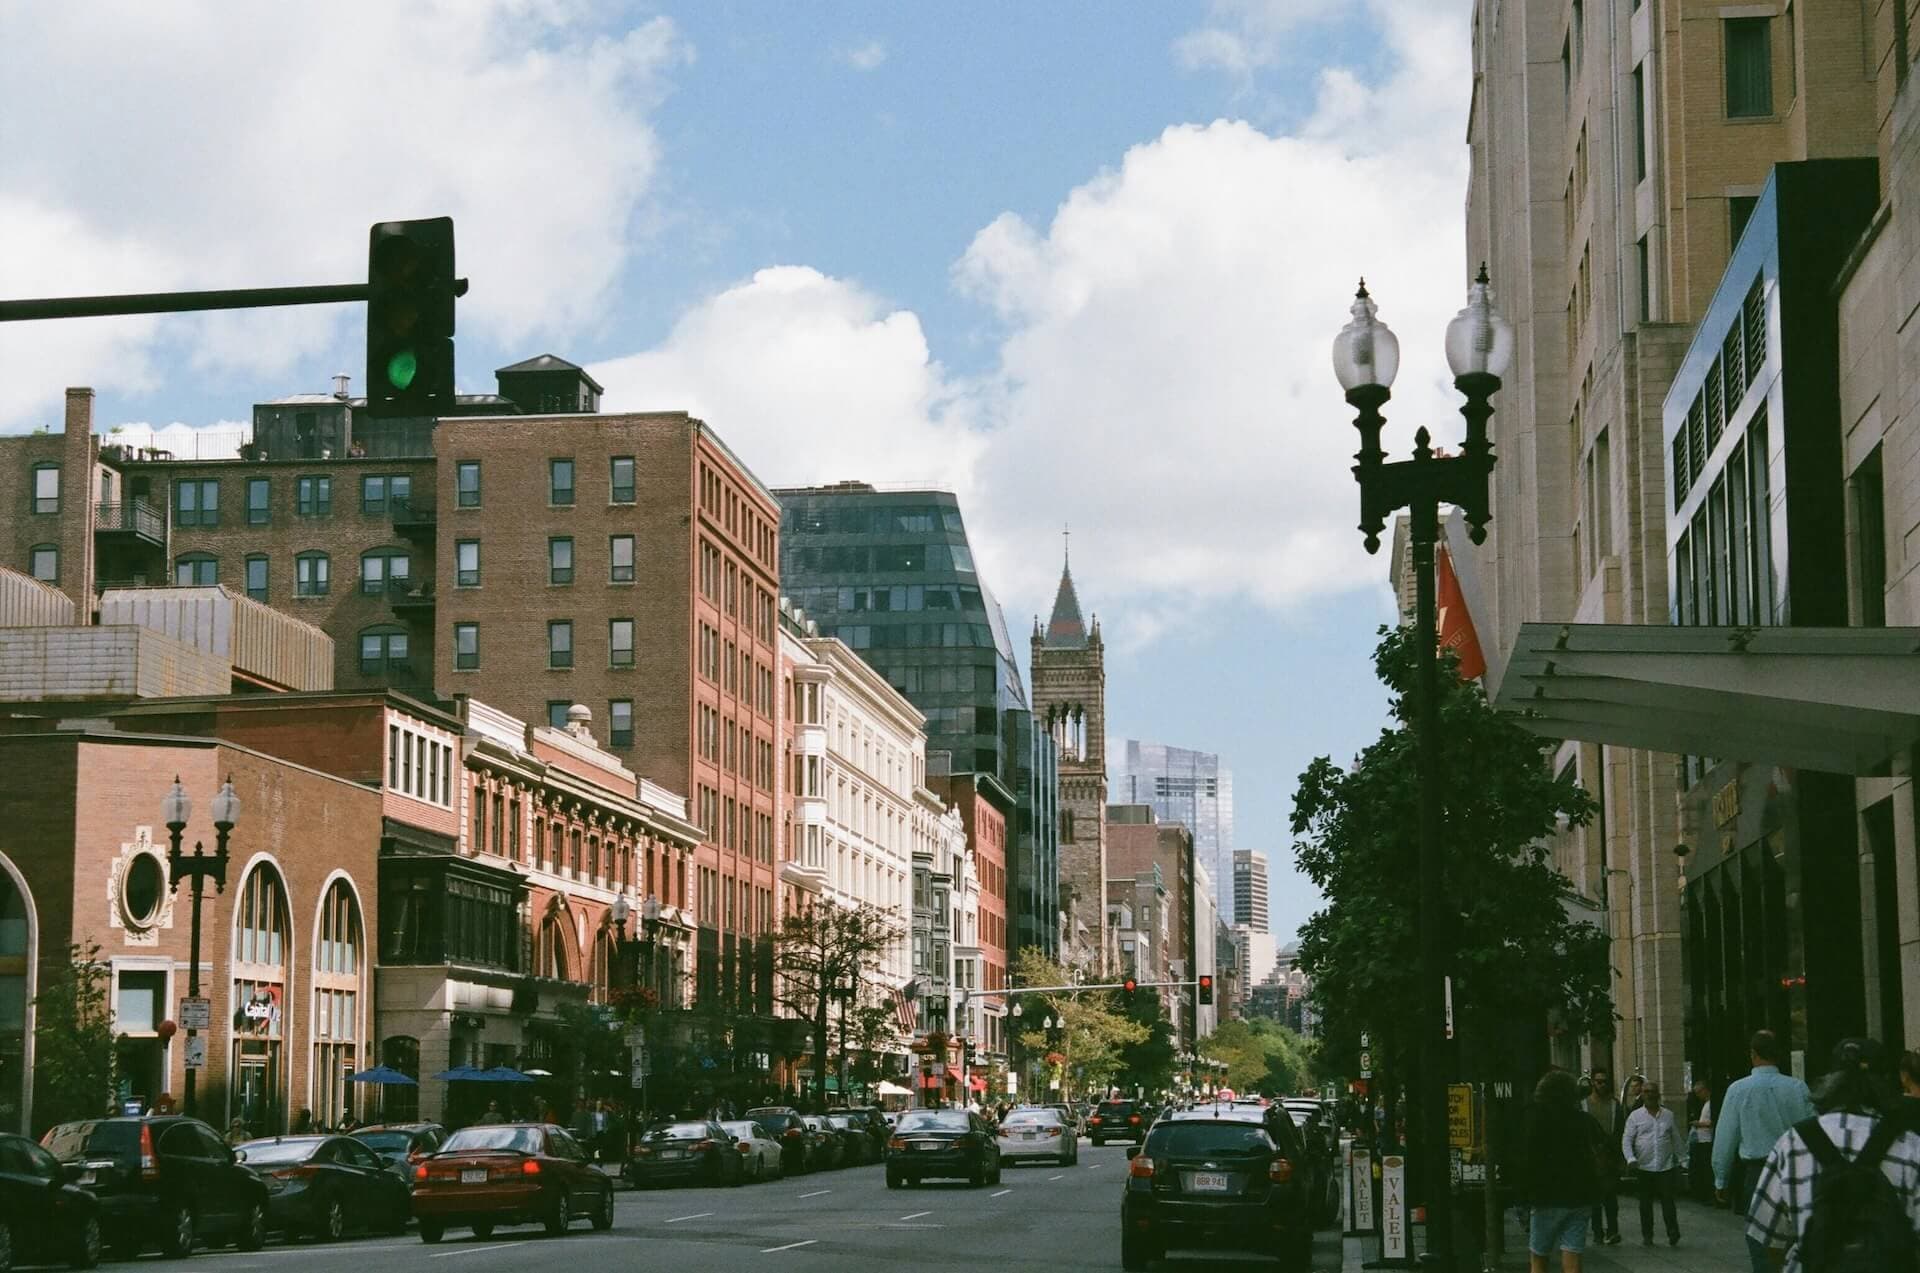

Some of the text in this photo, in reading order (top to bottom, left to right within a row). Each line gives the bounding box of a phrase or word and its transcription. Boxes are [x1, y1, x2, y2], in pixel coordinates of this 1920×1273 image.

[245, 1001, 270, 1020] Capital
[1358, 1166, 1369, 1223] VALET
[1387, 1178, 1400, 1250] VALET
